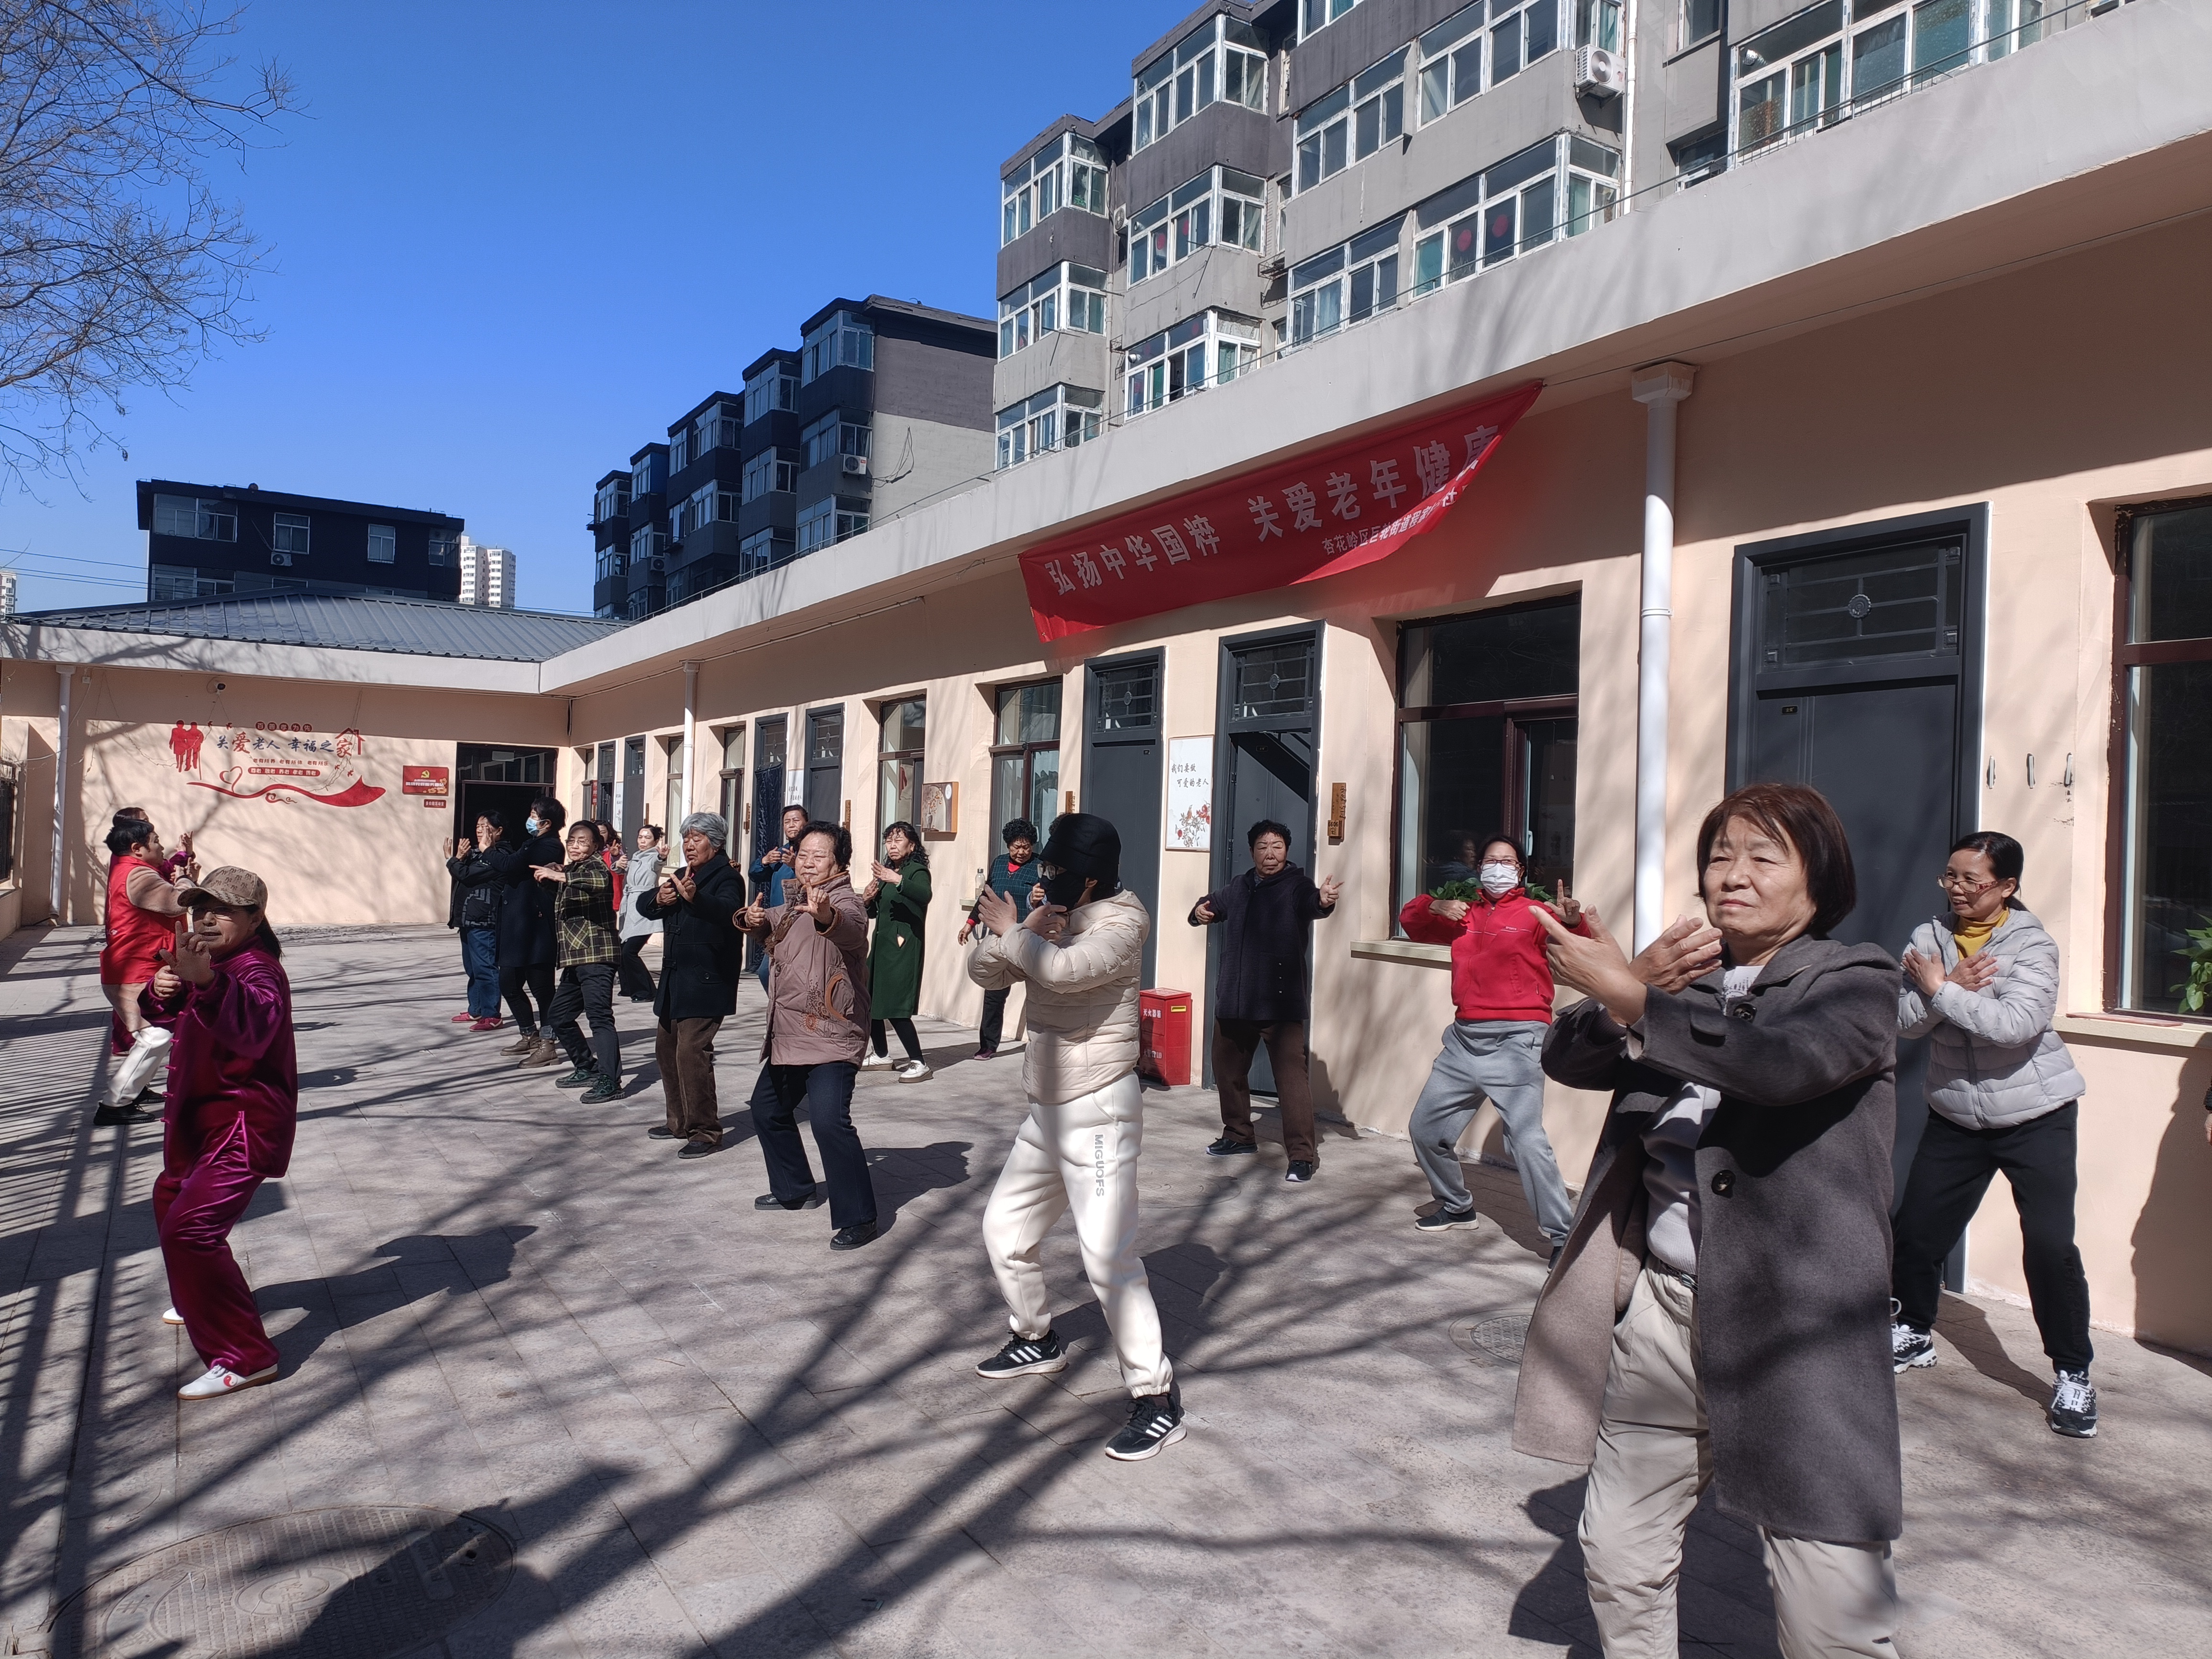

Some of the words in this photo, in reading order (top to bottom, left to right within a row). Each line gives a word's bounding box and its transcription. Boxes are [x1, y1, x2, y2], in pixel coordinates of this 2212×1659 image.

[1044, 514, 1221, 596] 弘扬中华国粹
[257, 722, 311, 731] 百善孝为先
[217, 731, 281, 754] 关爱老人
[288, 737, 353, 758] 幸福之家
[1171, 763, 1196, 774] 我们要做
[1177, 777, 1209, 788] 可爱的老人
[1143, 1008, 1161, 1018] 灭火器箱
[1095, 1134, 1105, 1197] MIGUOFS
